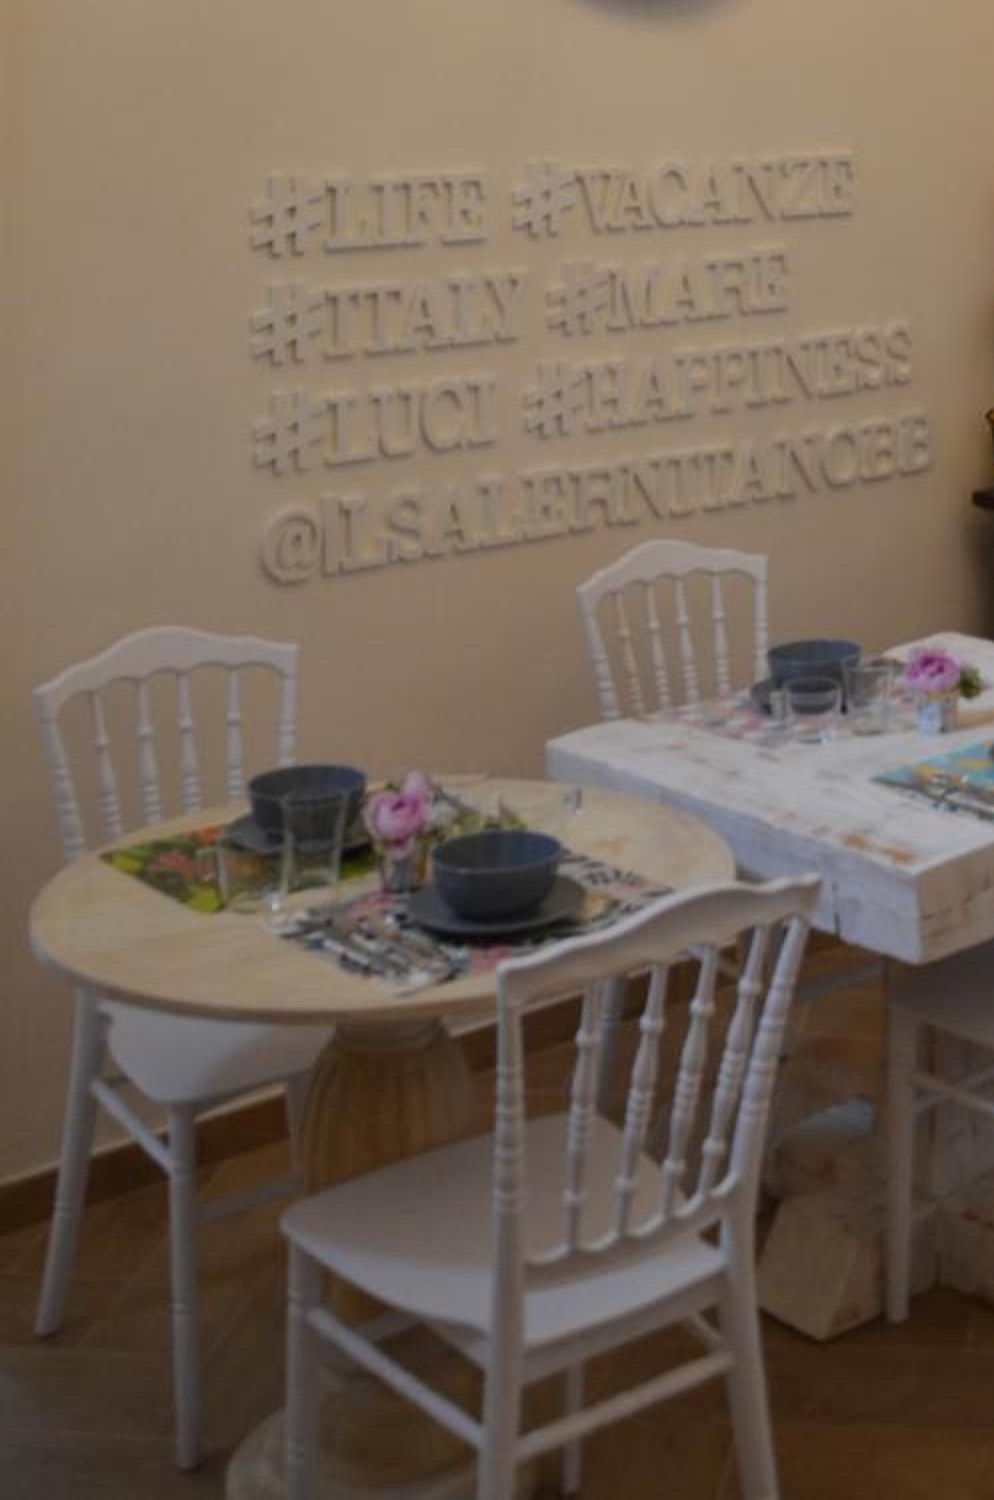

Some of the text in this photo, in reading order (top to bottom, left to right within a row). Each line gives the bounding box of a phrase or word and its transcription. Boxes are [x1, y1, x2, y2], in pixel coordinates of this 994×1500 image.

[250, 150, 857, 258] #LIFE #VACANZE
[250, 245, 791, 368] #ITALY #MARE
[251, 320, 913, 477] #LUCI #HAPPINESS
